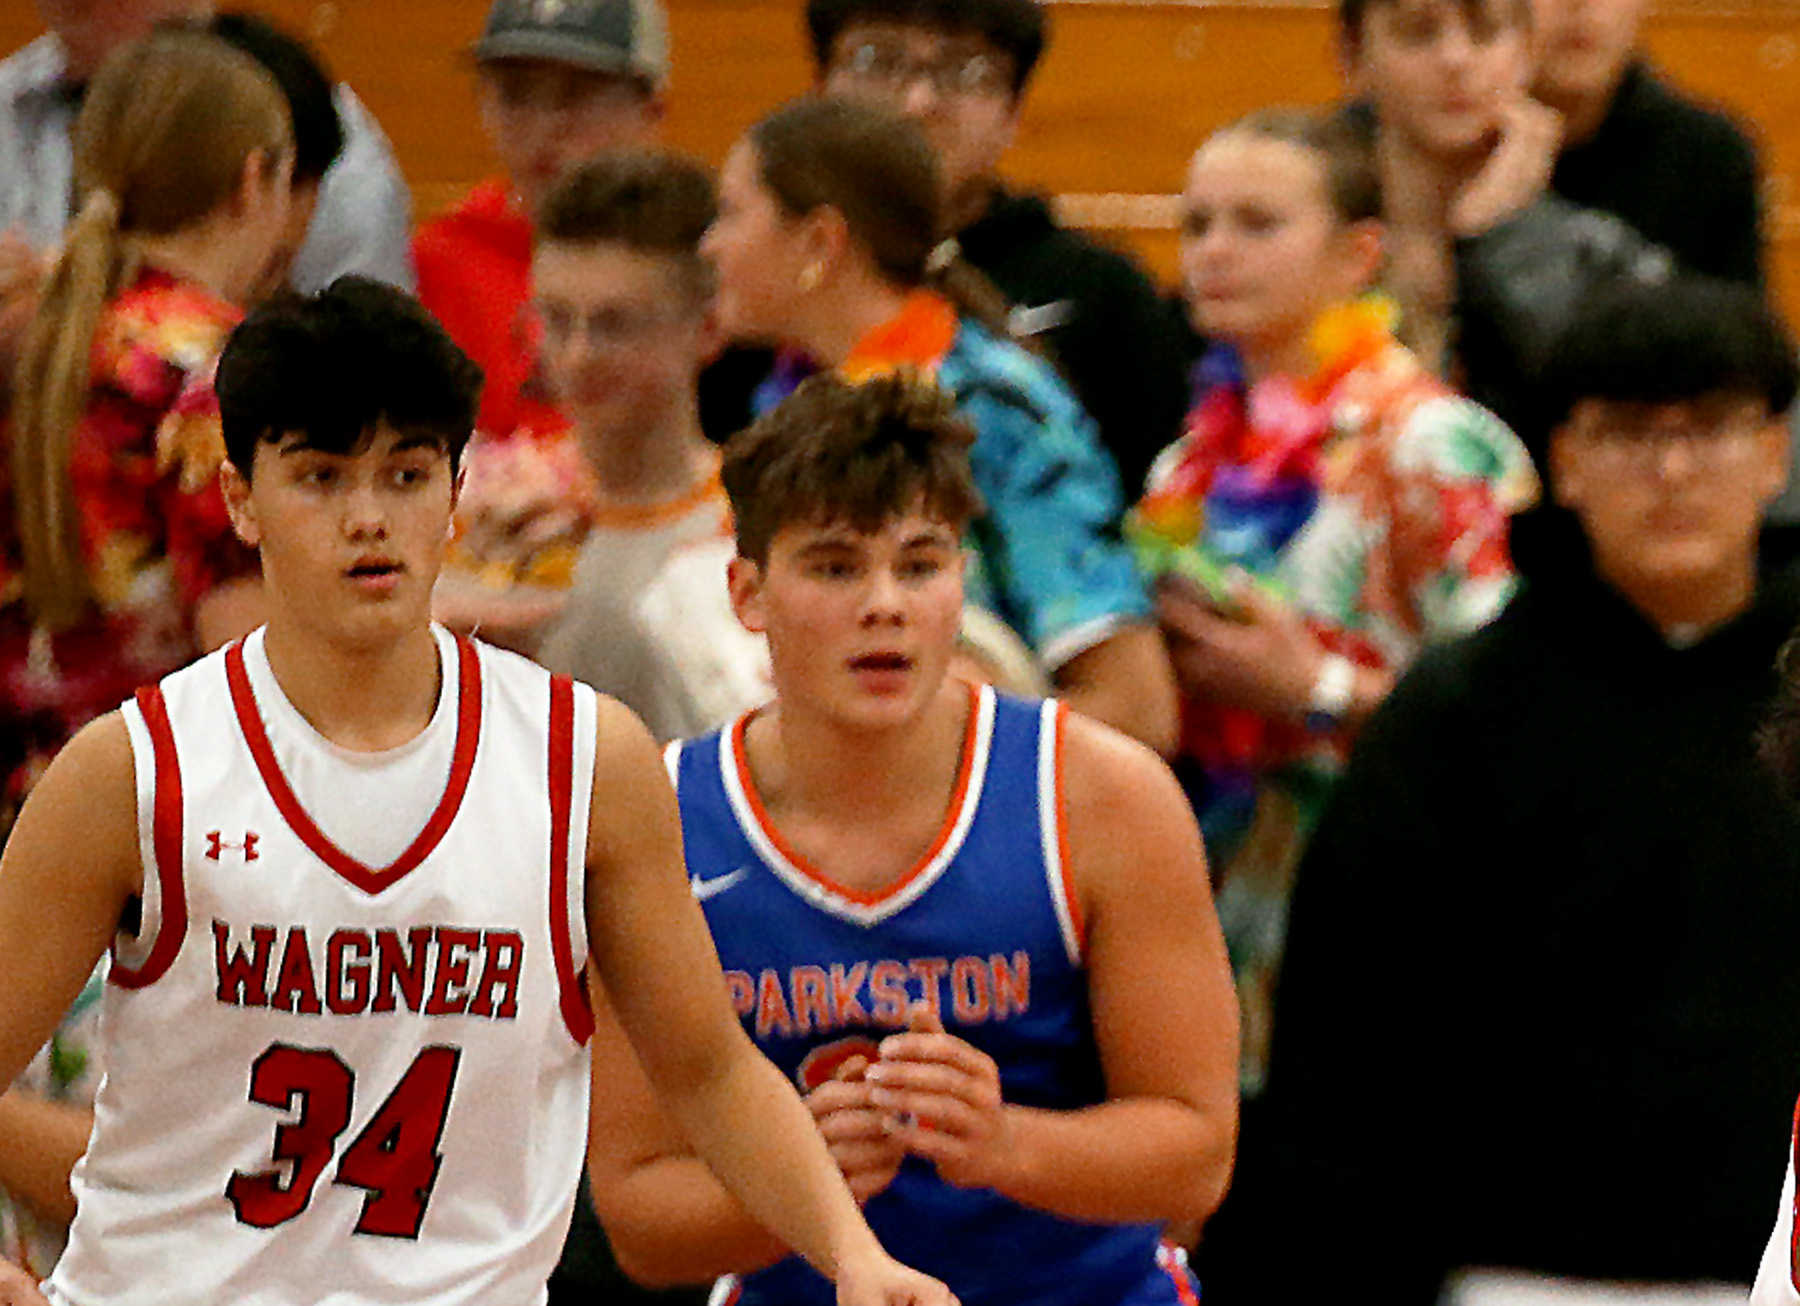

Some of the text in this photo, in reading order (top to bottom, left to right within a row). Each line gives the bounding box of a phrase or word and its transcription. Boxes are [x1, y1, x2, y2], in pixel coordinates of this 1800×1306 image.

[211, 918, 524, 1020] WAGNER
[722, 950, 1031, 1039] PARKSTON
[224, 1040, 462, 1240] 34
